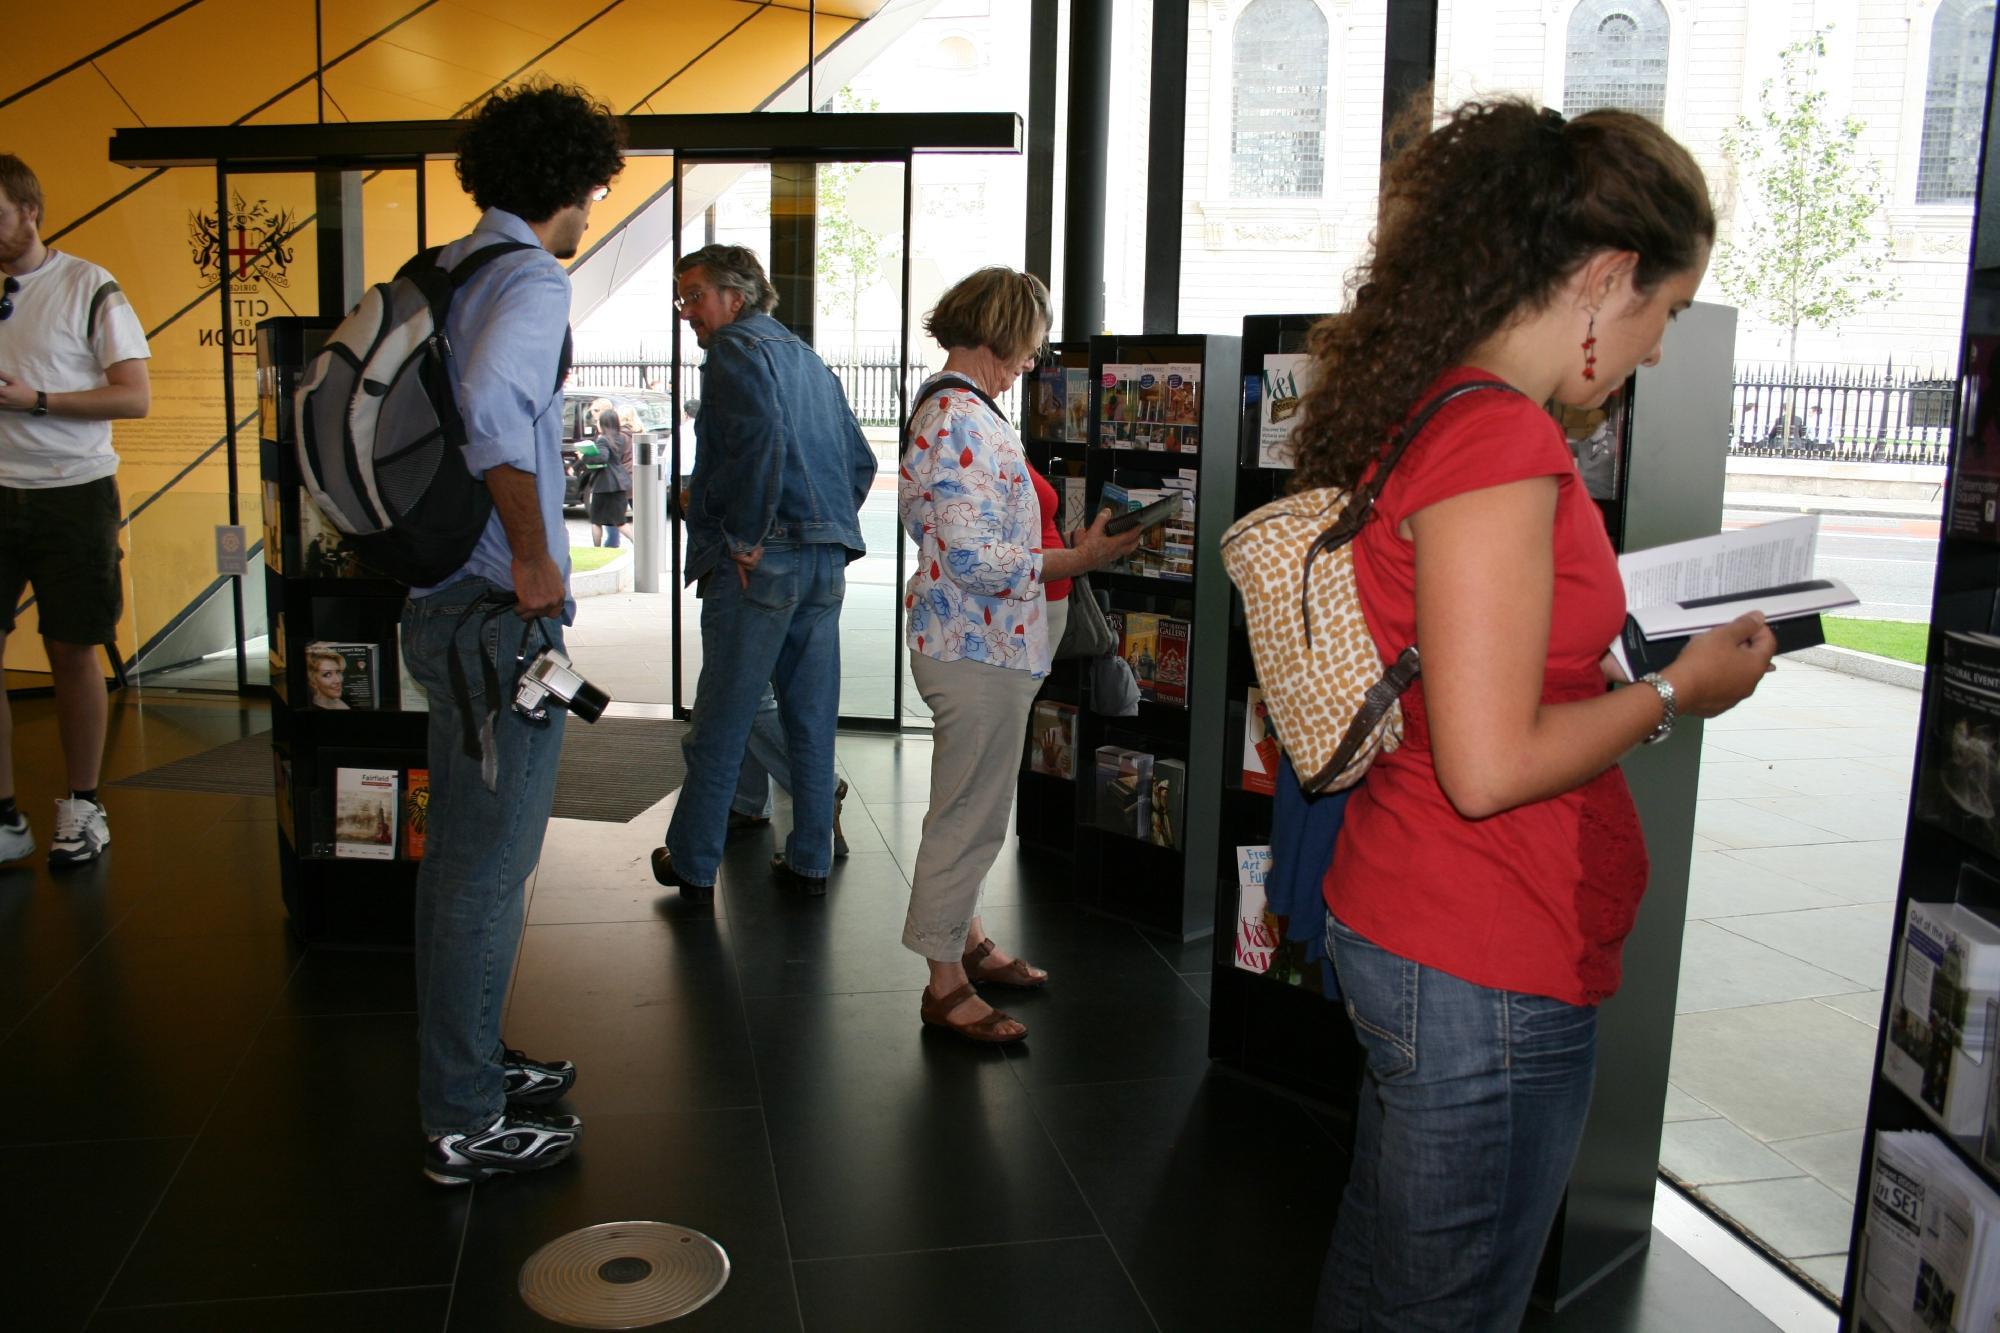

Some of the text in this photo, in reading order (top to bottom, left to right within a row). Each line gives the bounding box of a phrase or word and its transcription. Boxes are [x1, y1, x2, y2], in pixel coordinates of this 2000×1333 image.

[1262, 368, 1299, 400] V&A
[1160, 627, 1188, 638] GALLERY
[1973, 671, 2000, 689] EVENT
[362, 774, 390, 782] Fairfield
[1247, 848, 1273, 861] Free
[1241, 860, 1261, 871] Art
[1890, 1187, 1919, 1221] SE1
